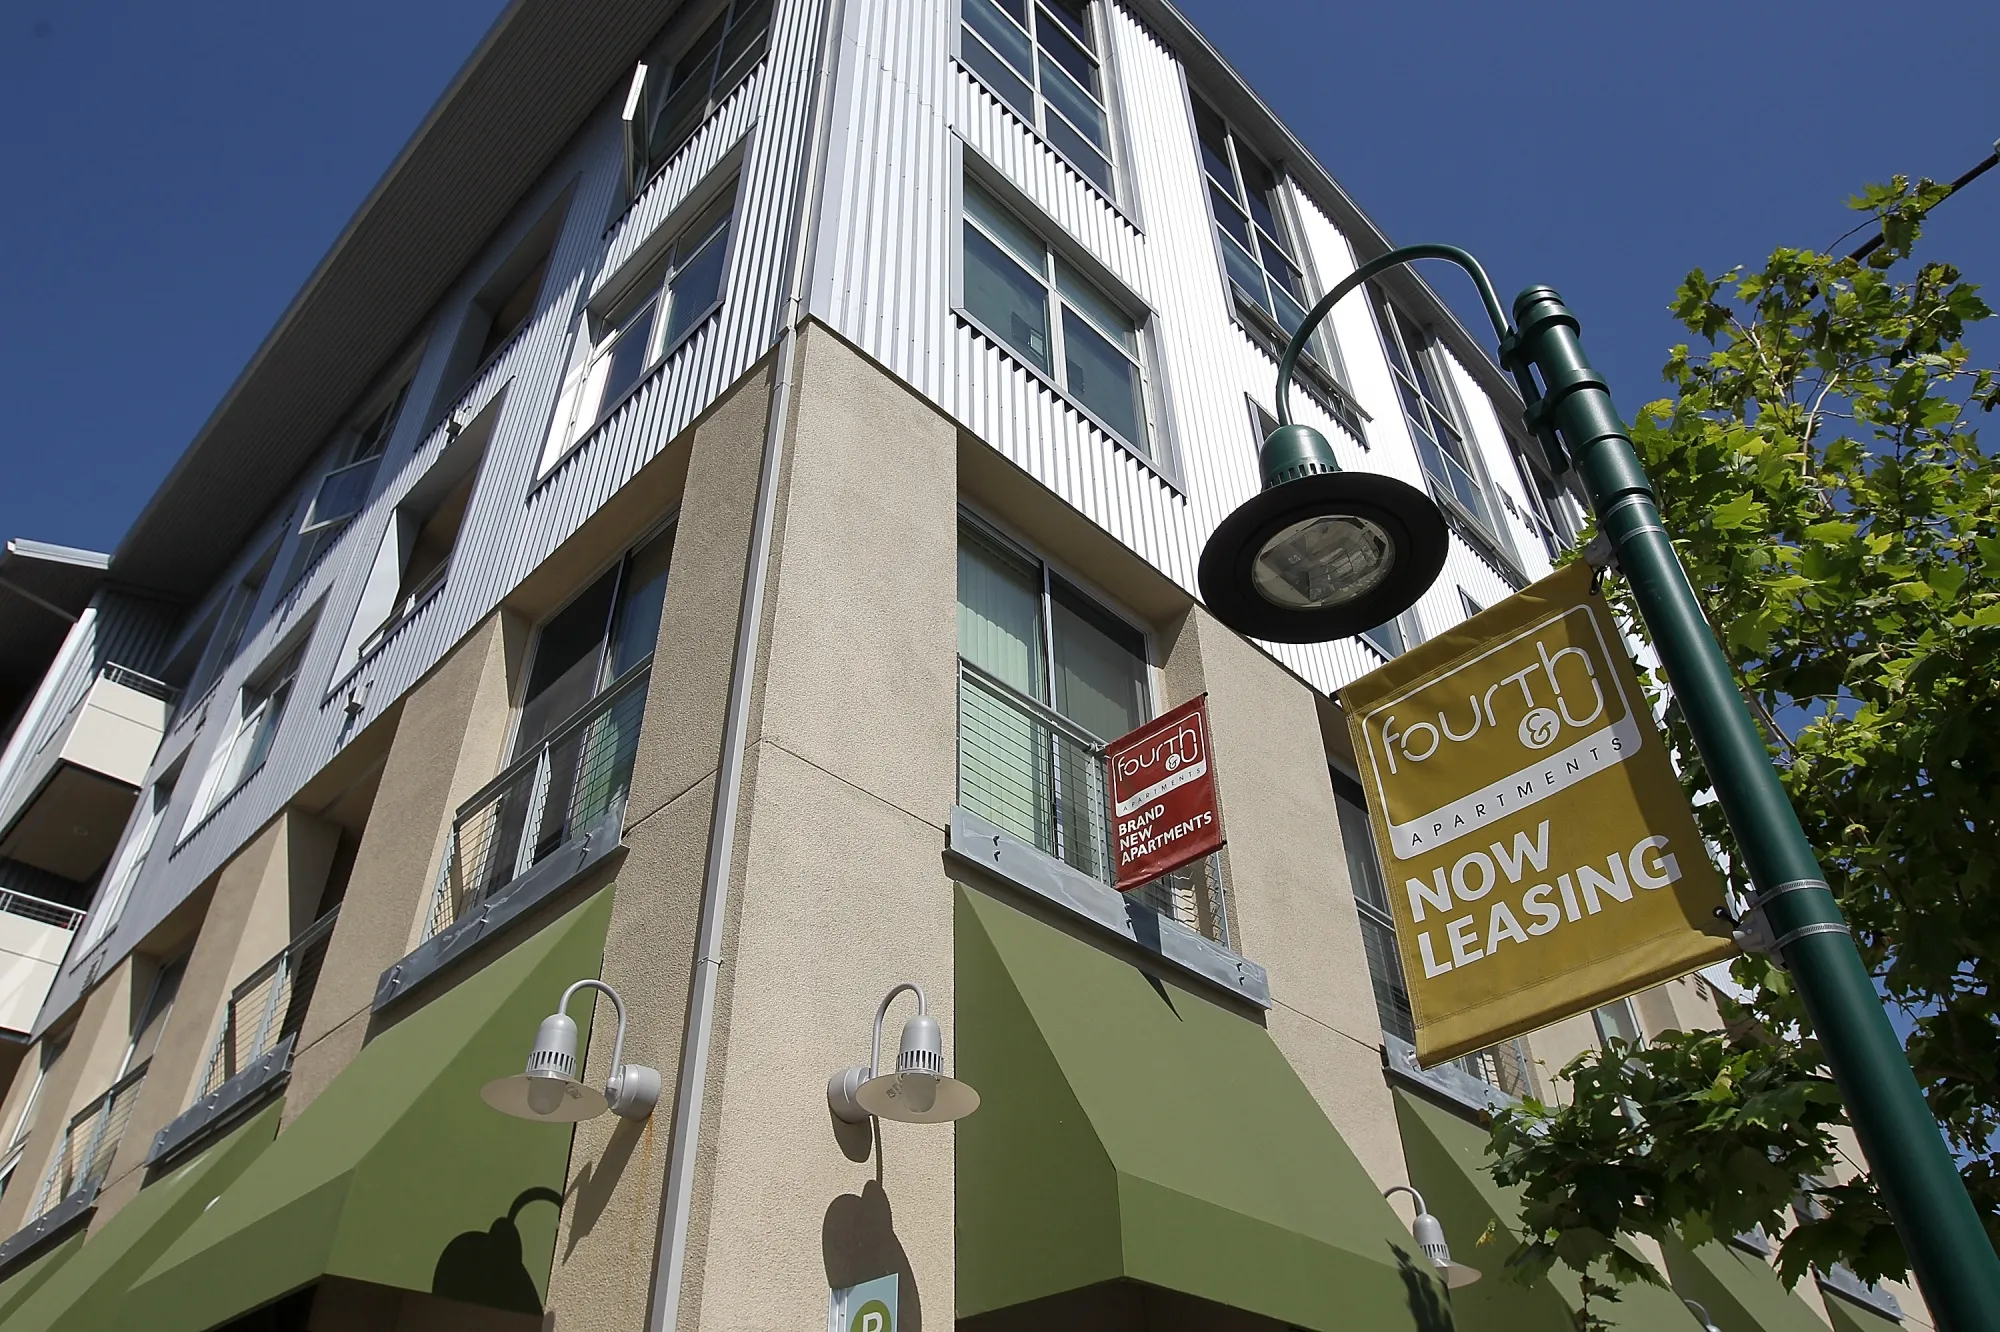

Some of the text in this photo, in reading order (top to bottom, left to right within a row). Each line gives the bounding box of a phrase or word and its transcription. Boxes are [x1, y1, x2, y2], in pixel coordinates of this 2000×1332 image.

[1122, 767, 1201, 812] APARTMENTS
[1411, 737, 1623, 847] APARTMENTS
[1118, 803, 1166, 837] BRAND
[1119, 824, 1154, 852] NEW
[1121, 810, 1213, 866] APARTMENTS
[1405, 819, 1550, 924] NOW
[1417, 834, 1683, 980] LEASING
